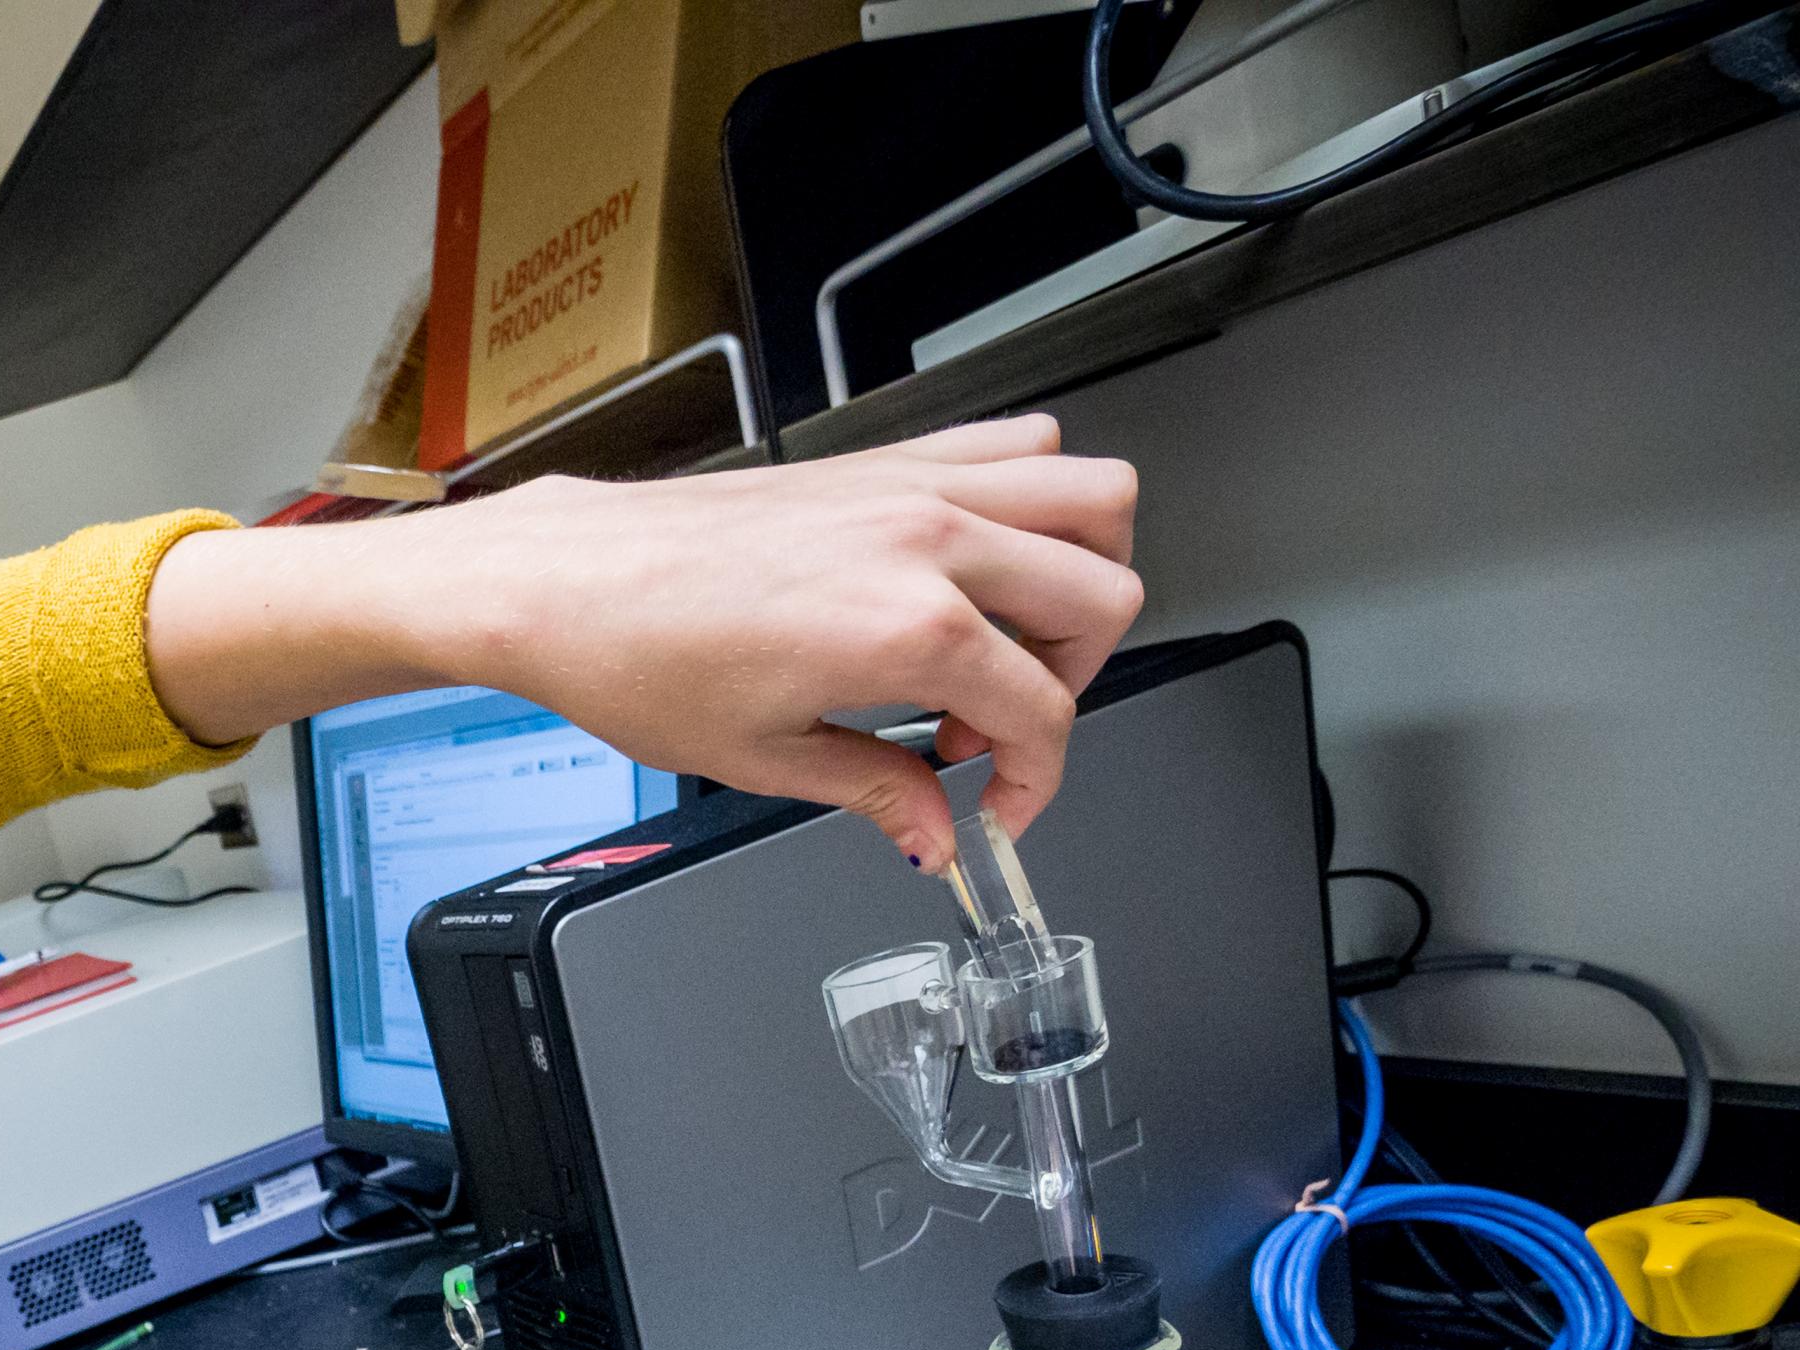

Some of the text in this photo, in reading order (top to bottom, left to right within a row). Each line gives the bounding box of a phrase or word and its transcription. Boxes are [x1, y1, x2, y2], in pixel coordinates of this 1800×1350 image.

[489, 180, 640, 313] LABORATORY
[486, 256, 604, 358] PRODUCTS
[441, 914, 488, 925] OPTIPLEX
